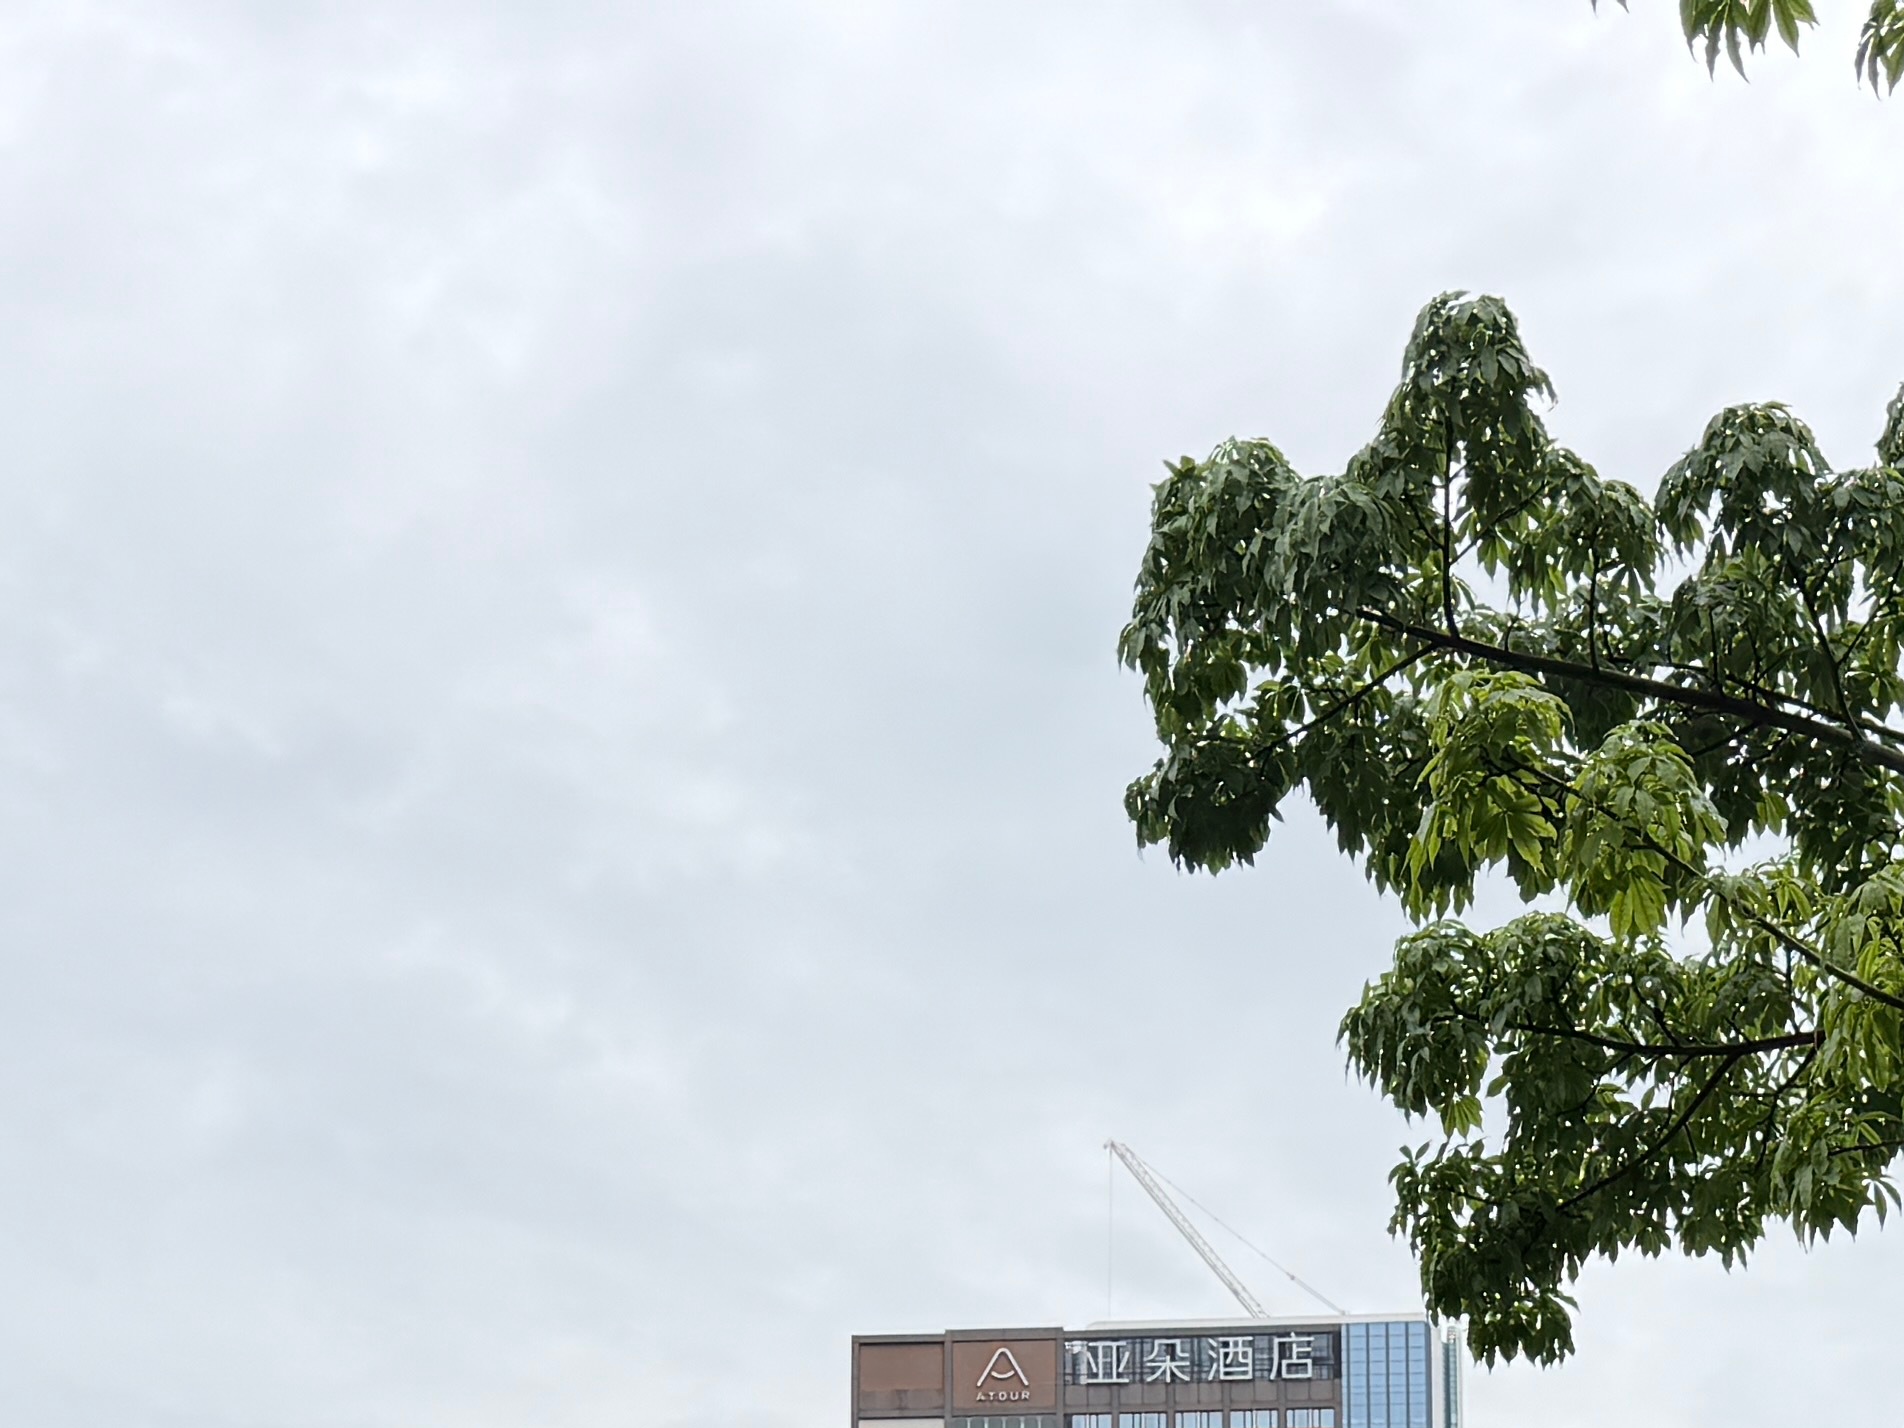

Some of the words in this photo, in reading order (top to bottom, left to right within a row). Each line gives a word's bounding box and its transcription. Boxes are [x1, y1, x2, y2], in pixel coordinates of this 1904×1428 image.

[1081, 1332, 1315, 1384] 亚朵酒店
[976, 1390, 1031, 1401] ATOUR
